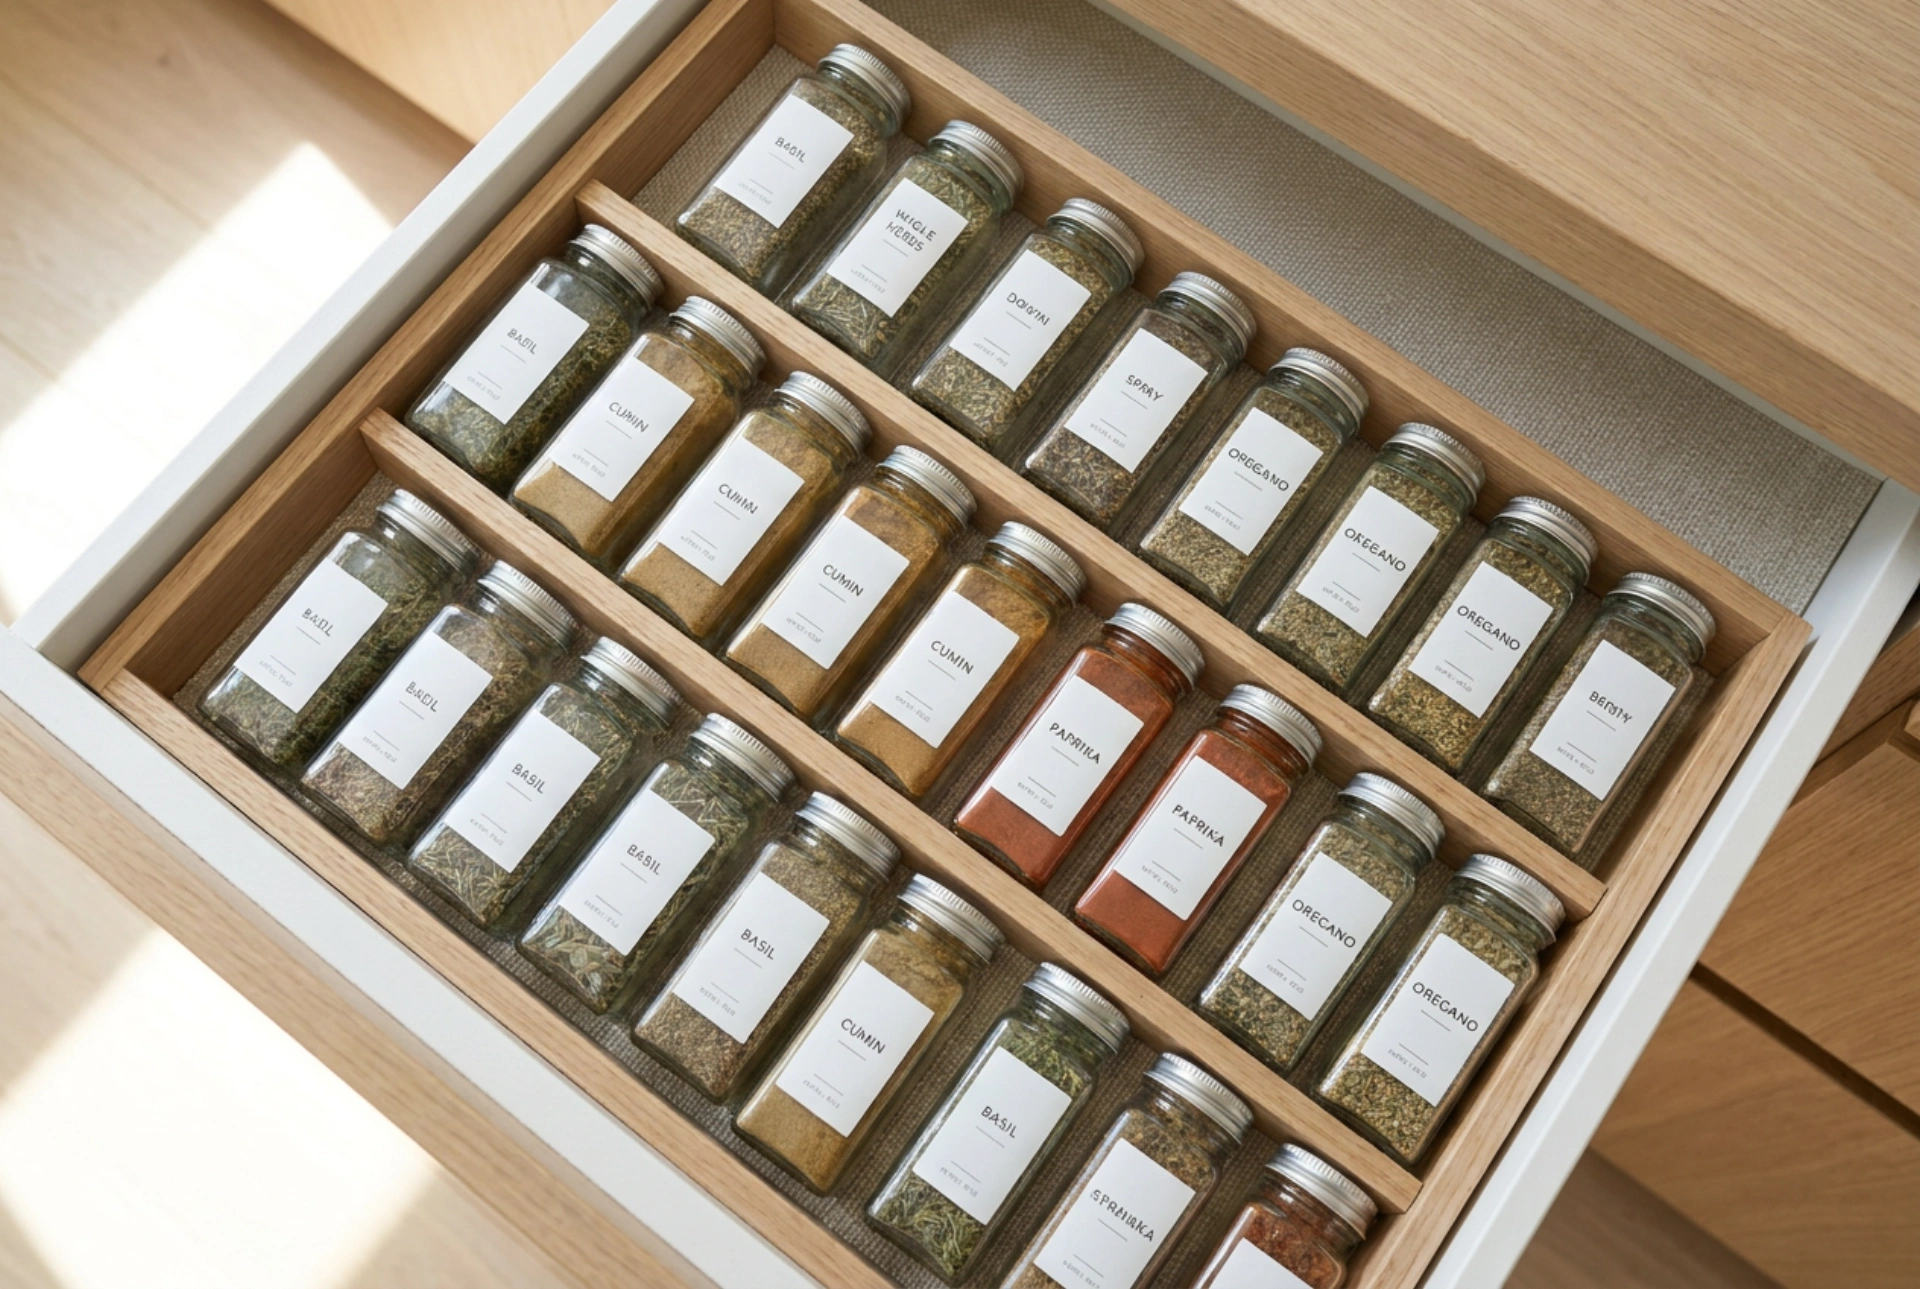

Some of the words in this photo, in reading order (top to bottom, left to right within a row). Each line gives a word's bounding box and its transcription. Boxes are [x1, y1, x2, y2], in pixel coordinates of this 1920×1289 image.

[822, 564, 864, 597] CUMIN
[1457, 605, 1520, 651] OREGANO
[930, 640, 975, 675] CUMIN
[1172, 804, 1225, 848] PAPRIKA
[740, 929, 775, 959] BASIL
[981, 1106, 1016, 1138] BASIL
